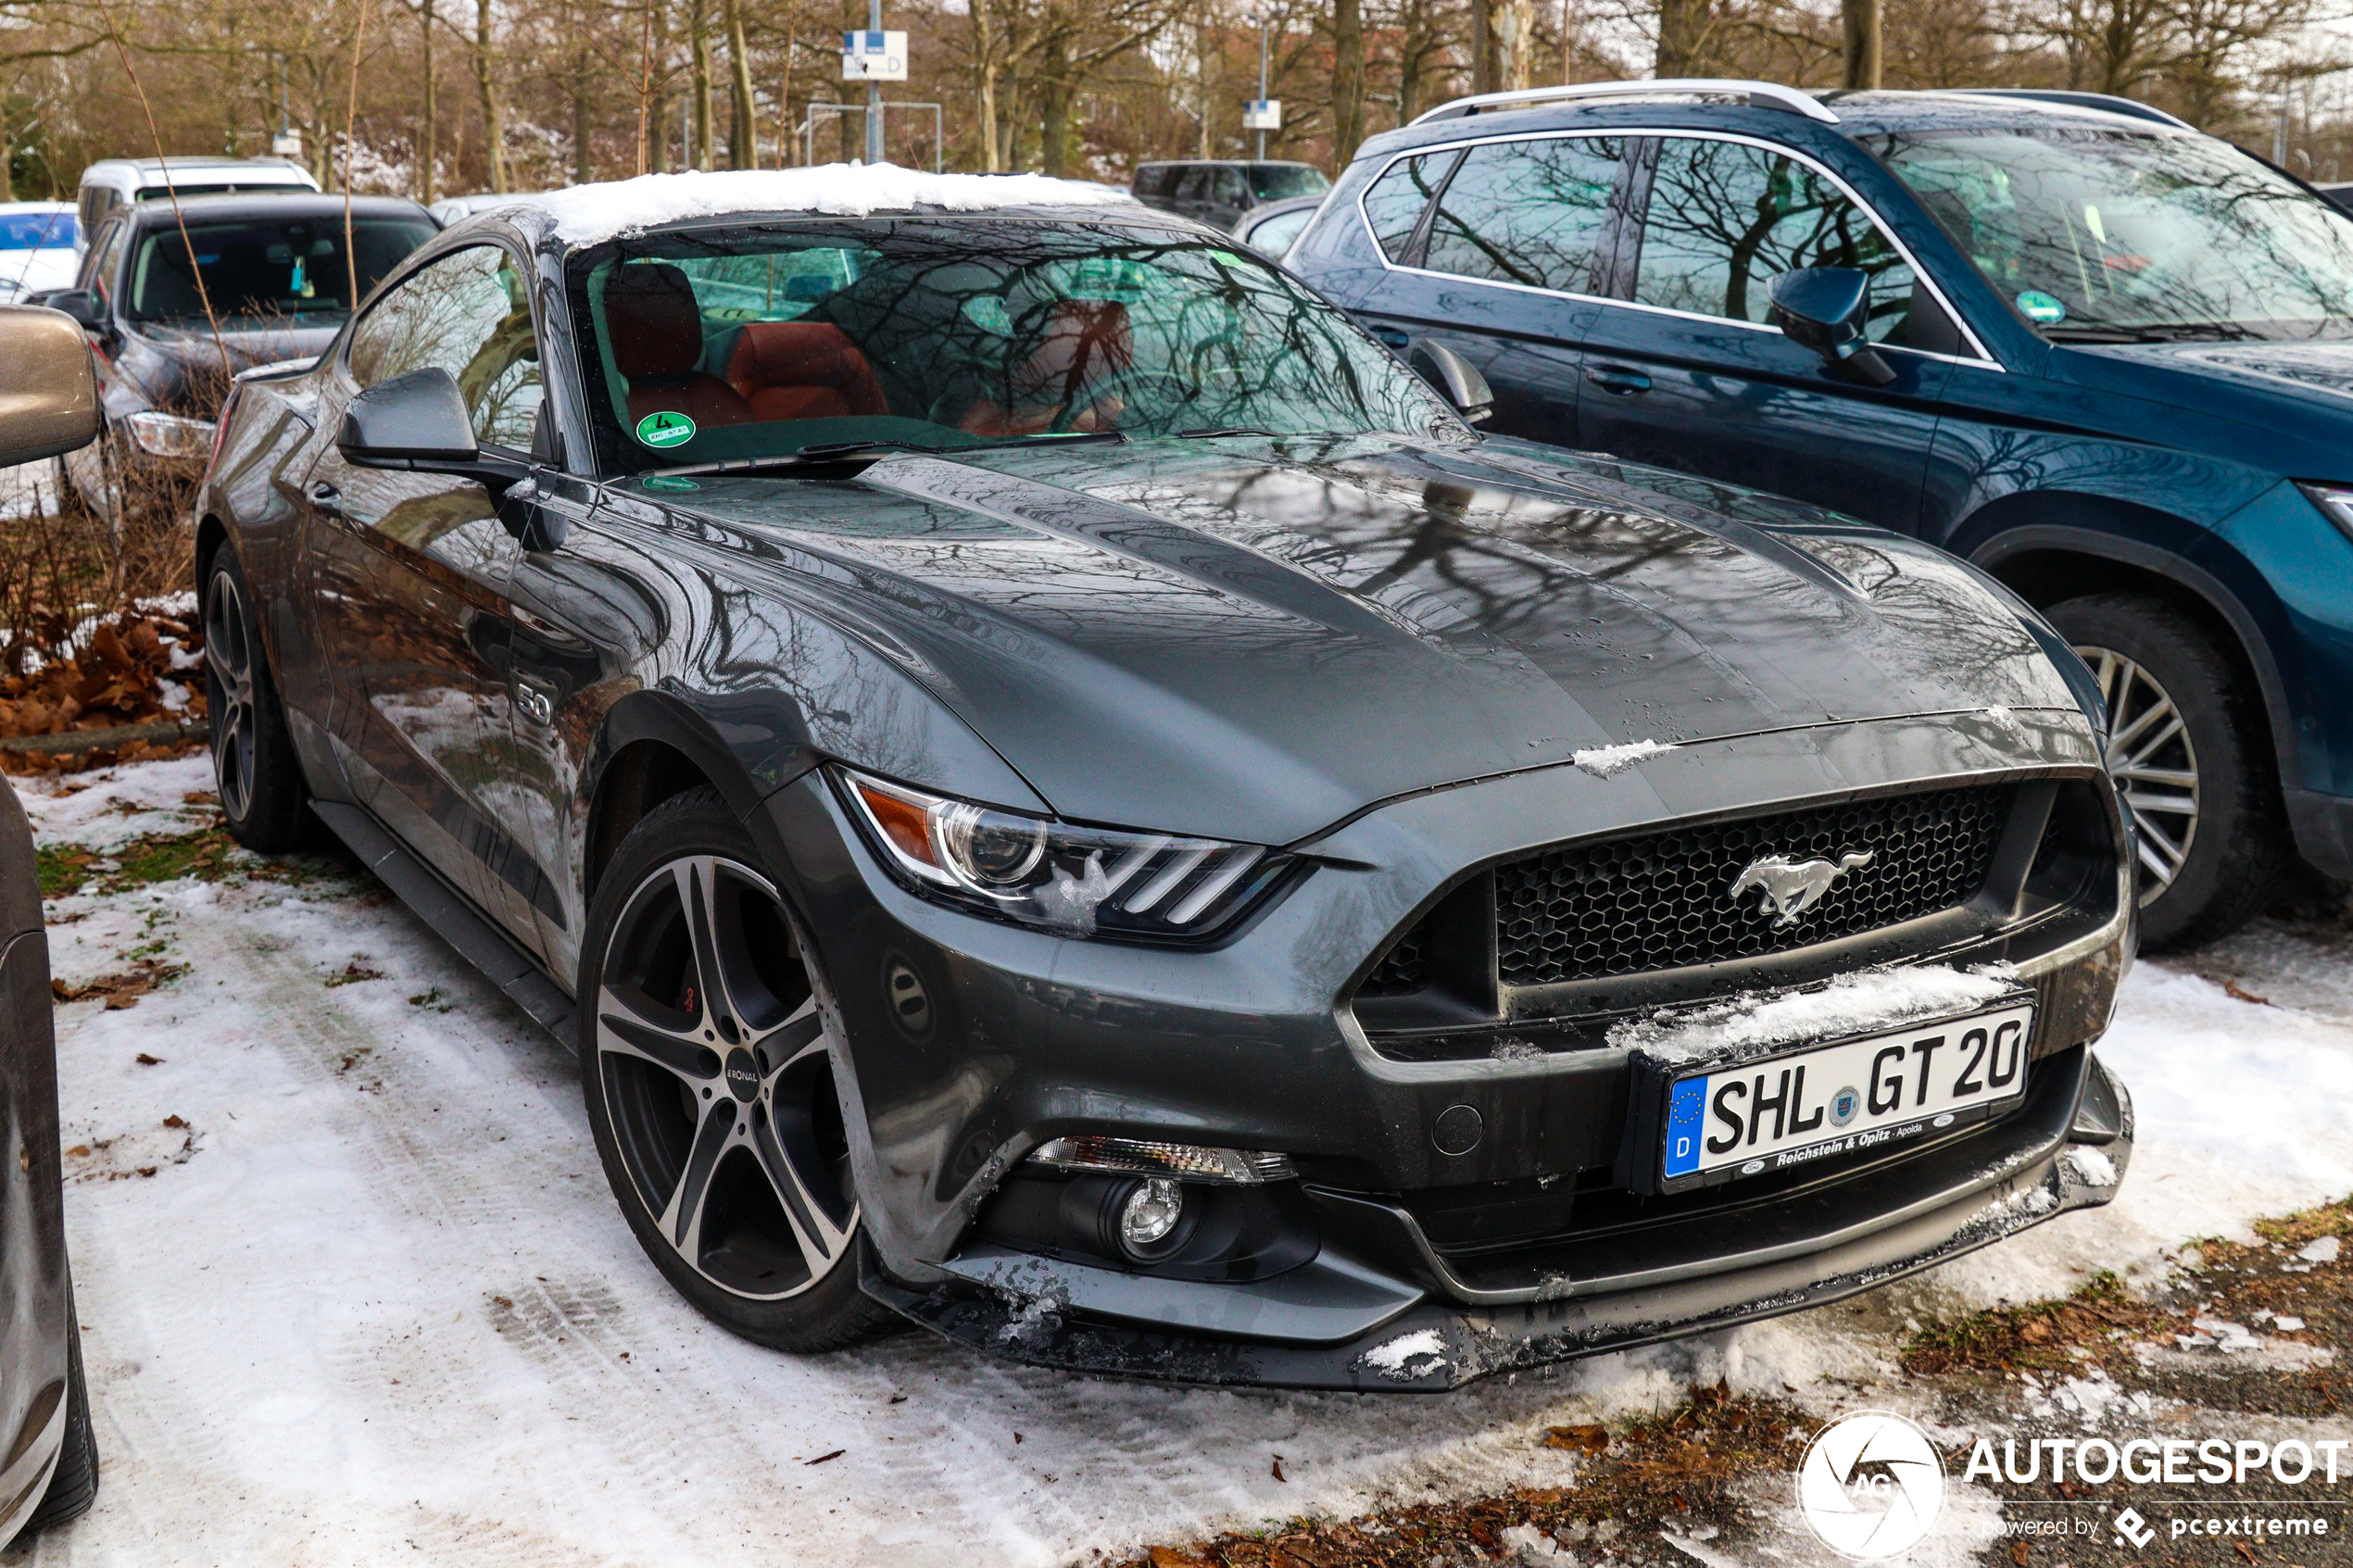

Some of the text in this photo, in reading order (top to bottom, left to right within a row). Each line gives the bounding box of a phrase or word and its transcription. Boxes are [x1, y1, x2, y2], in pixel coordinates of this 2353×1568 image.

[657, 415, 673, 429] 4
[732, 1069, 758, 1082] RONAL
[1706, 1020, 2021, 1154] SHL GT 20
[1676, 1136, 1691, 1158] D
[1777, 1123, 1923, 1167] Reichstein & Opitz Apolda
